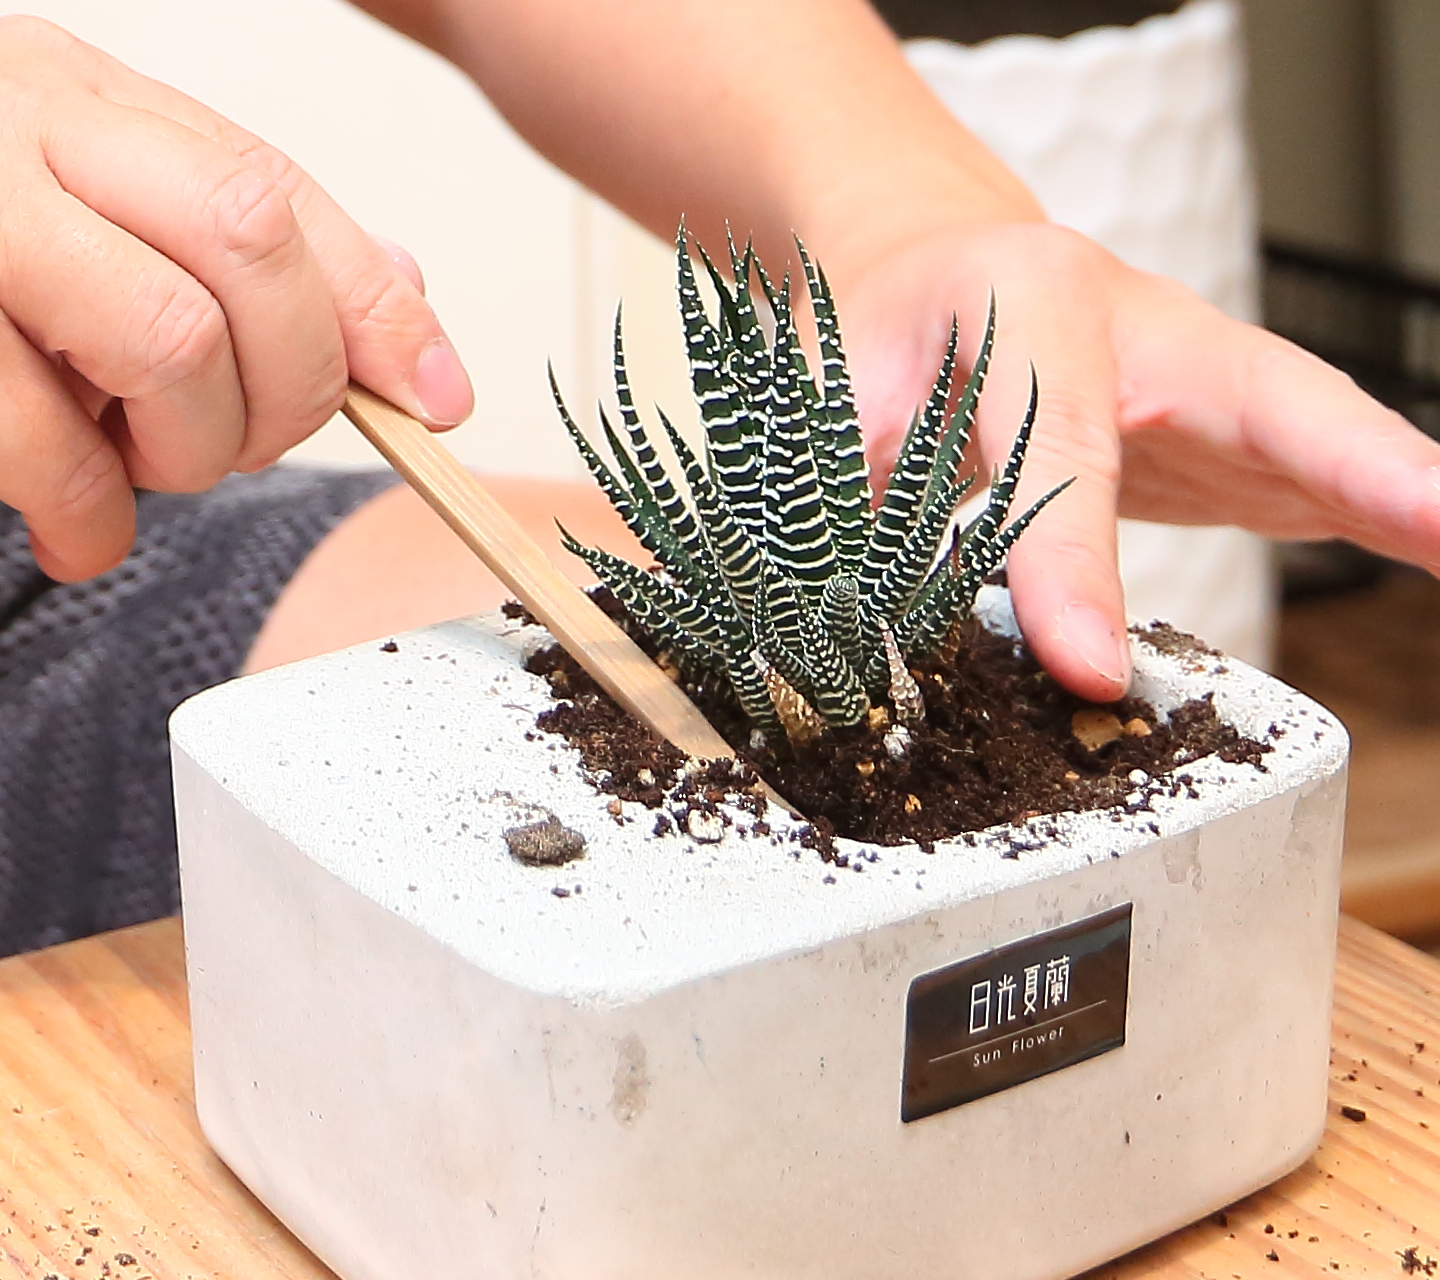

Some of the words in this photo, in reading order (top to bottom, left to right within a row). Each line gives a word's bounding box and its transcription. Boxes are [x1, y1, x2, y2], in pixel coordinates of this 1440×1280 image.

[969, 954, 1070, 1035] 日光夏蘭
[973, 1048, 1001, 1068] Sun
[1012, 1026, 1065, 1054] Flower
